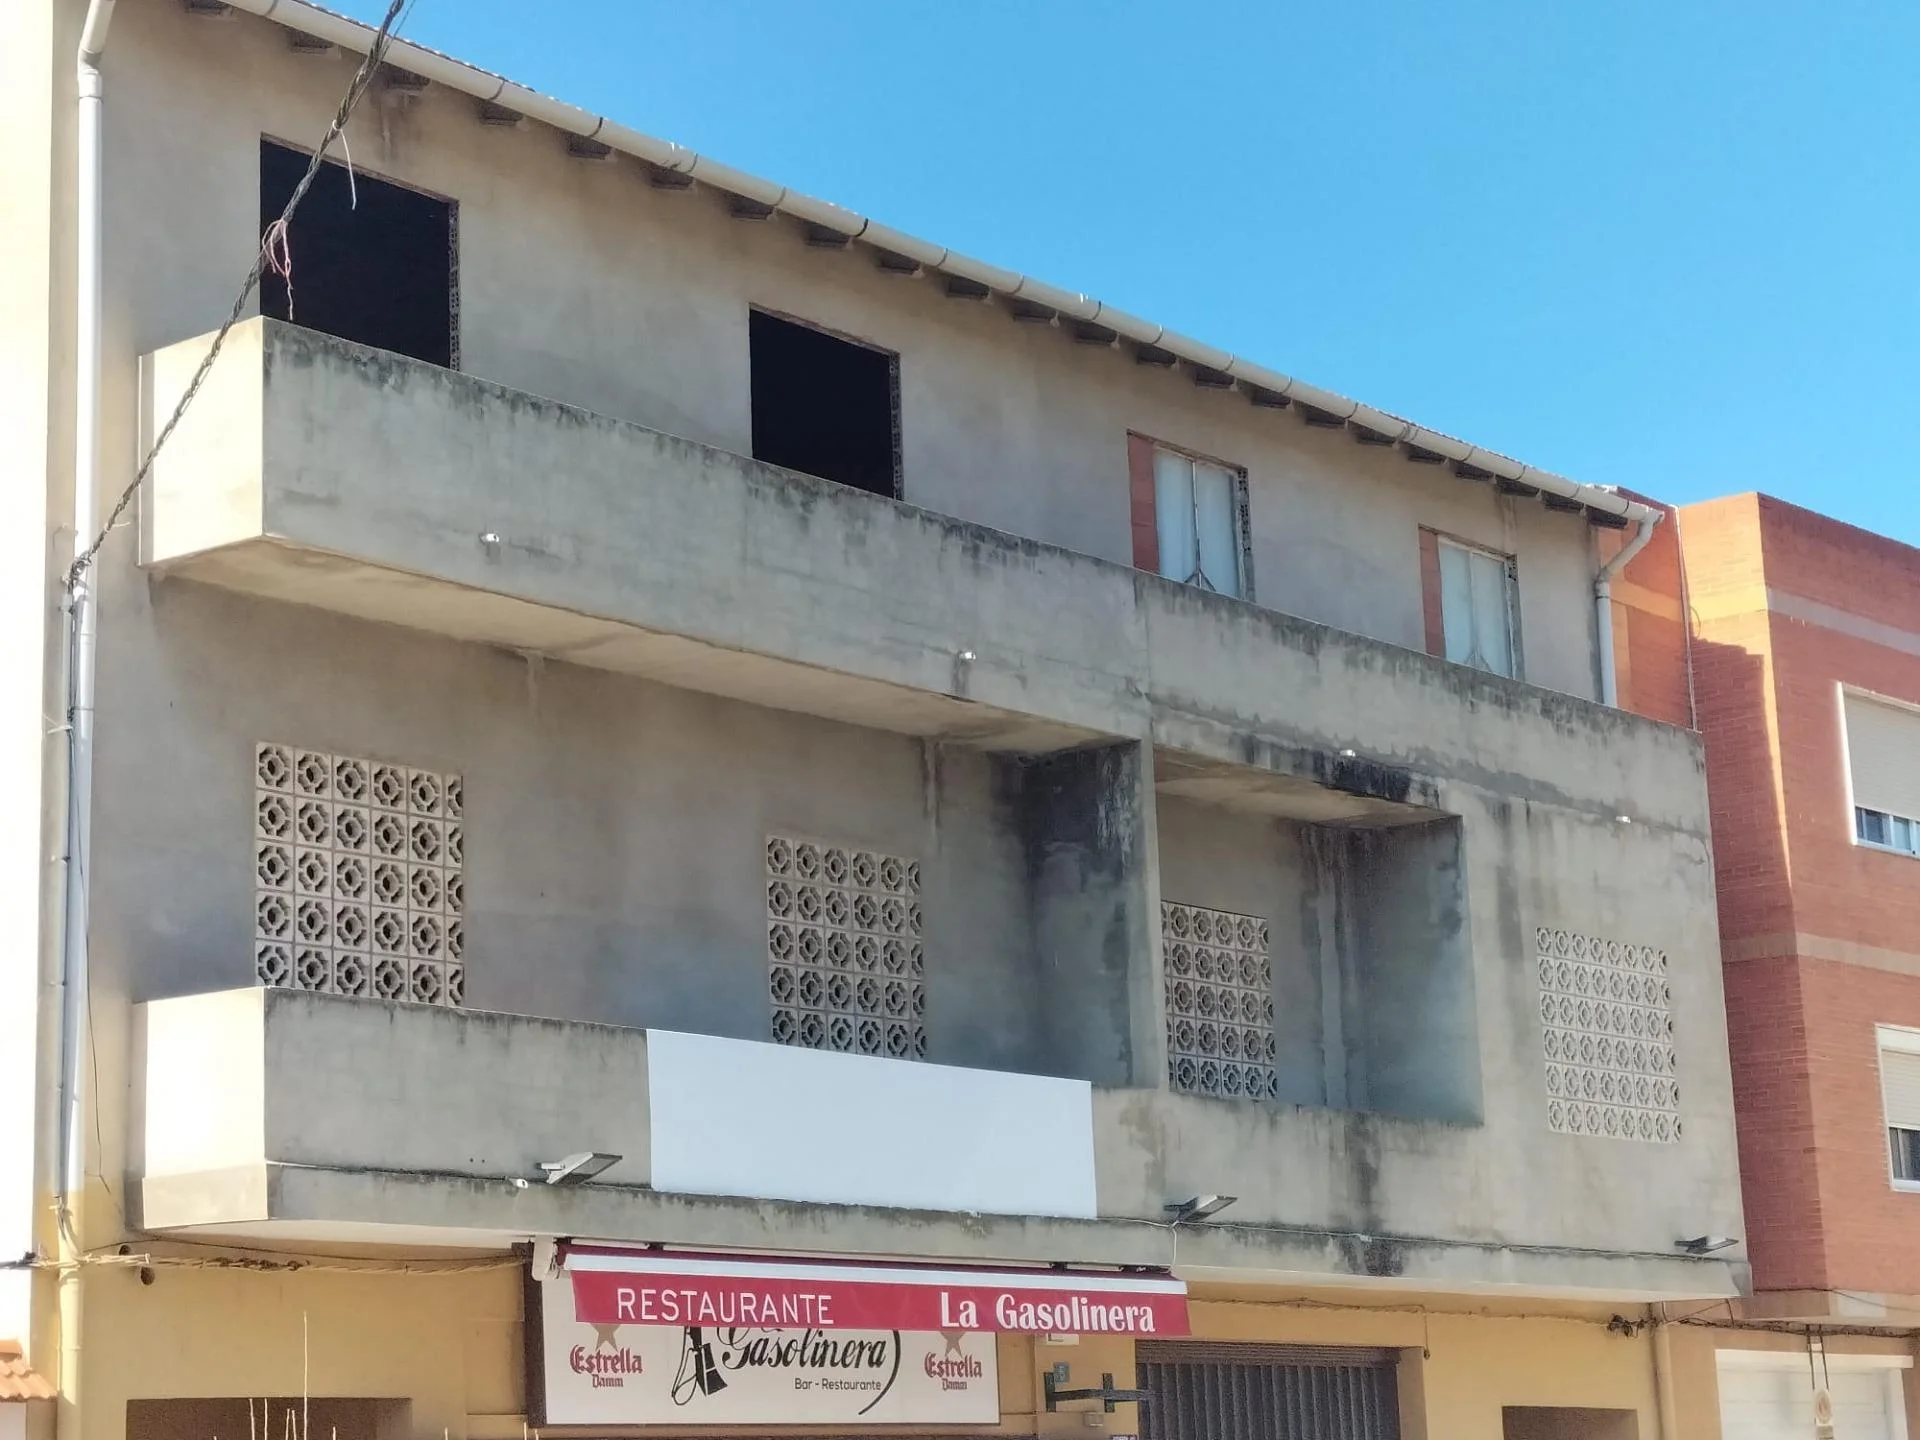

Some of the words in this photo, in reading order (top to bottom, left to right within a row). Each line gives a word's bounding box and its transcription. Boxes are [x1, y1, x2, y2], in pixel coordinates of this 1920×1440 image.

[617, 1288, 834, 1325] RESTAURANTE
[941, 1291, 979, 1329] La
[996, 1293, 1156, 1332] Gasolinera
[569, 1344, 643, 1374] Estrella
[924, 1351, 983, 1378] Estrella
[592, 1373, 624, 1388] Damm
[794, 1378, 812, 1390] Bar
[821, 1378, 882, 1391] Restaurante
